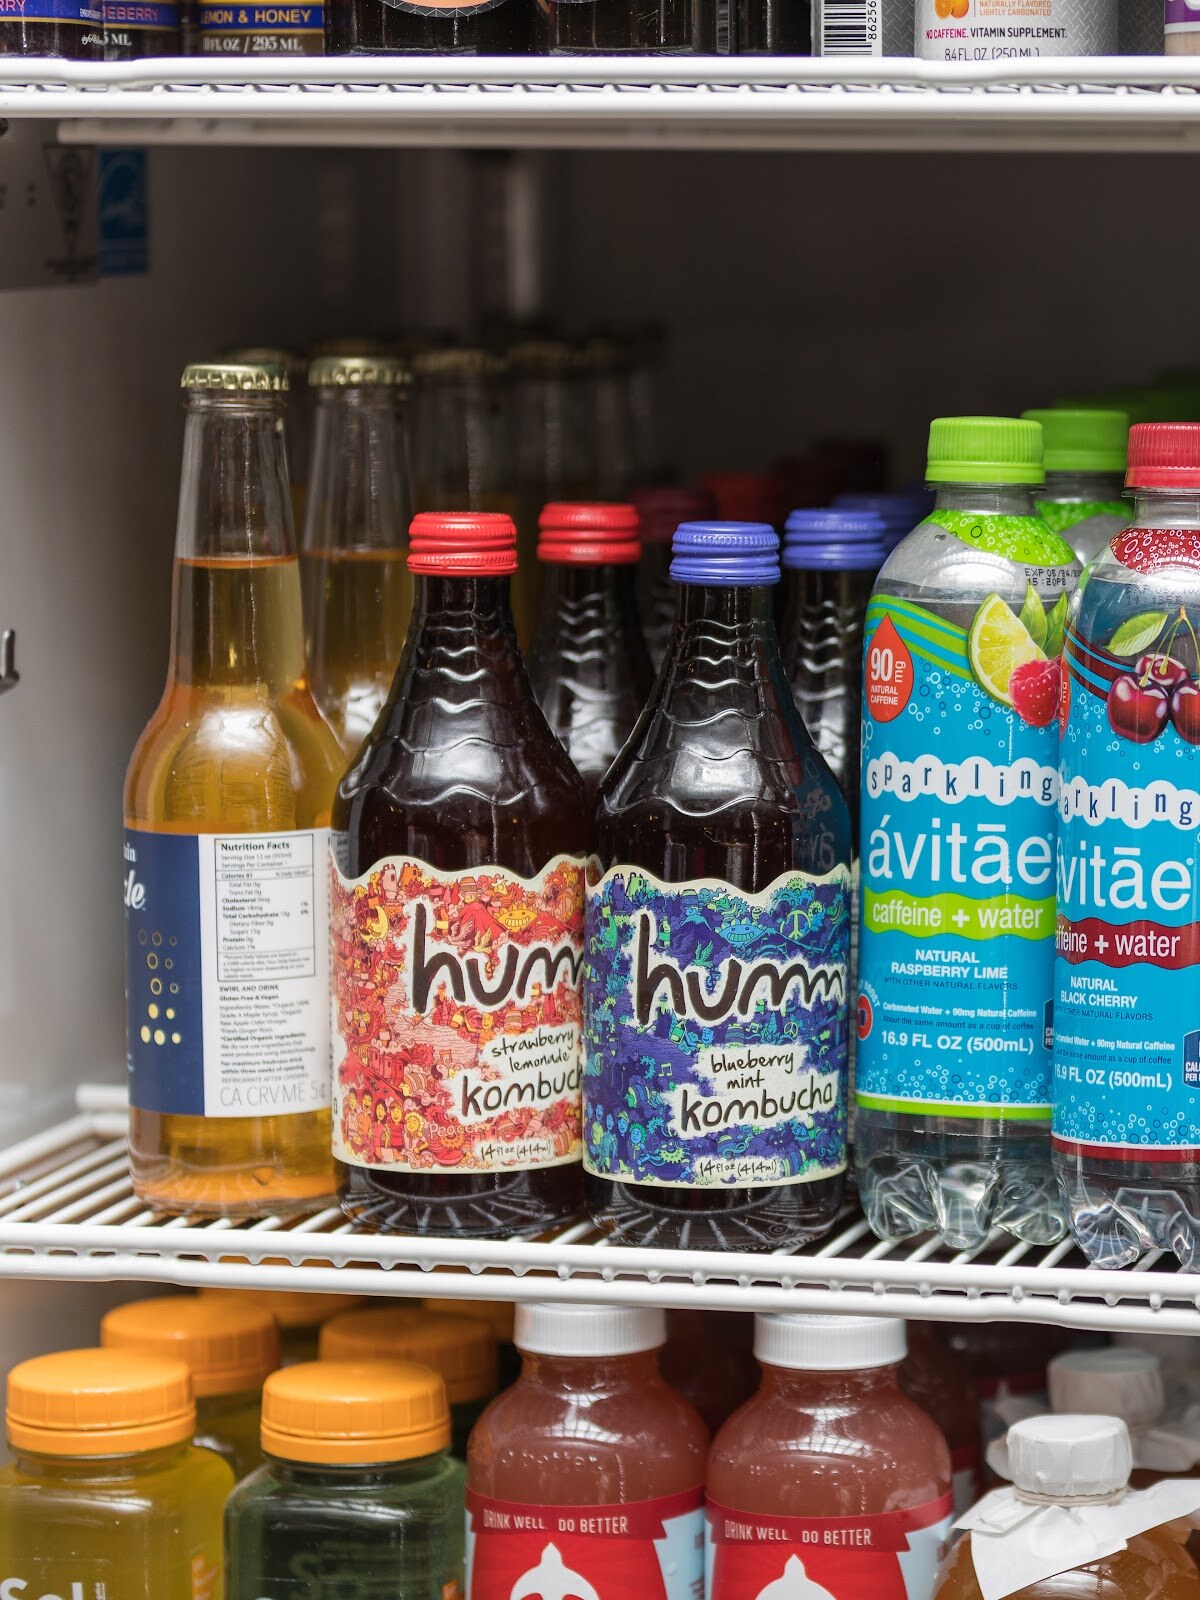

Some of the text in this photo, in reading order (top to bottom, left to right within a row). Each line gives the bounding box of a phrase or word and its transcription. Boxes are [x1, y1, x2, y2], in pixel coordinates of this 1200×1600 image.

[103, 6, 160, 21] EBERRY
[238, 10, 249, 23] &
[255, 9, 311, 23] HONEY
[1008, 9, 1052, 17] CARBONATED
[926, 27, 1067, 39] NO CAFFEINE. VITAMIN SUPPLEMENT.
[253, 35, 303, 51] 295 ML
[1024, 567, 1044, 577] EXP
[870, 648, 893, 682] 90
[894, 660, 906, 683] mg
[870, 685, 899, 696] NATURAL
[870, 695, 899, 706] CAFFEINE
[871, 763, 1053, 802] sparkling
[1062, 786, 1194, 826] arkling
[221, 841, 290, 852] Nutrition Facts
[221, 872, 245, 880] Calories
[1059, 839, 1192, 911] vitāe
[238, 911, 279, 919] Carbohydrate
[872, 899, 942, 928] caffeine
[977, 904, 1044, 929] water
[1055, 926, 1088, 954] affeine
[1114, 930, 1181, 958] water
[915, 949, 980, 964] NATURAL
[891, 962, 1009, 980] RASPBERRY LIME
[902, 978, 1018, 991] OTHER NATURAL FLAVORS
[1070, 975, 1118, 992] NATURAL
[1060, 990, 1139, 1009] BLACK CHERRY
[882, 1002, 1037, 1019] Carbonated Water 90mg Natural Caffeine
[1081, 1009, 1154, 1021] NATURAL FLAVORS
[901, 1016, 912, 1026] the
[913, 1020, 934, 1028] same
[935, 1020, 965, 1029] amount
[986, 1023, 1001, 1031] cup
[1012, 1022, 1034, 1031] coffee
[491, 1028, 575, 1059] strawberry
[881, 1030, 1034, 1055] 16.9 FL OZ (500mL)
[1097, 1038, 1115, 1050] 90mg
[1116, 1039, 1143, 1051] Natural
[1144, 1041, 1176, 1052] Caffeine
[508, 1050, 571, 1073] lemonade
[710, 1049, 795, 1075] blueberry
[1084, 1052, 1172, 1066] amount cup coffee
[727, 1071, 765, 1090] mint
[1069, 1066, 1083, 1084] FL
[1085, 1068, 1106, 1086] OZ
[1108, 1071, 1173, 1093] (500mL)
[1185, 1072, 1198, 1083] PER
[219, 1085, 242, 1107] CA
[681, 1076, 833, 1132] kombucha
[429, 1123, 474, 1140] Peace
[481, 1142, 496, 1161] 14
[700, 1161, 717, 1176] 14
[483, 1508, 511, 1529] DRINK
[513, 1511, 549, 1531] WELL.
[558, 1518, 575, 1533] DO
[724, 1519, 754, 1541] DRINK
[756, 1525, 793, 1544] WELL.
[801, 1529, 819, 1544] DO
